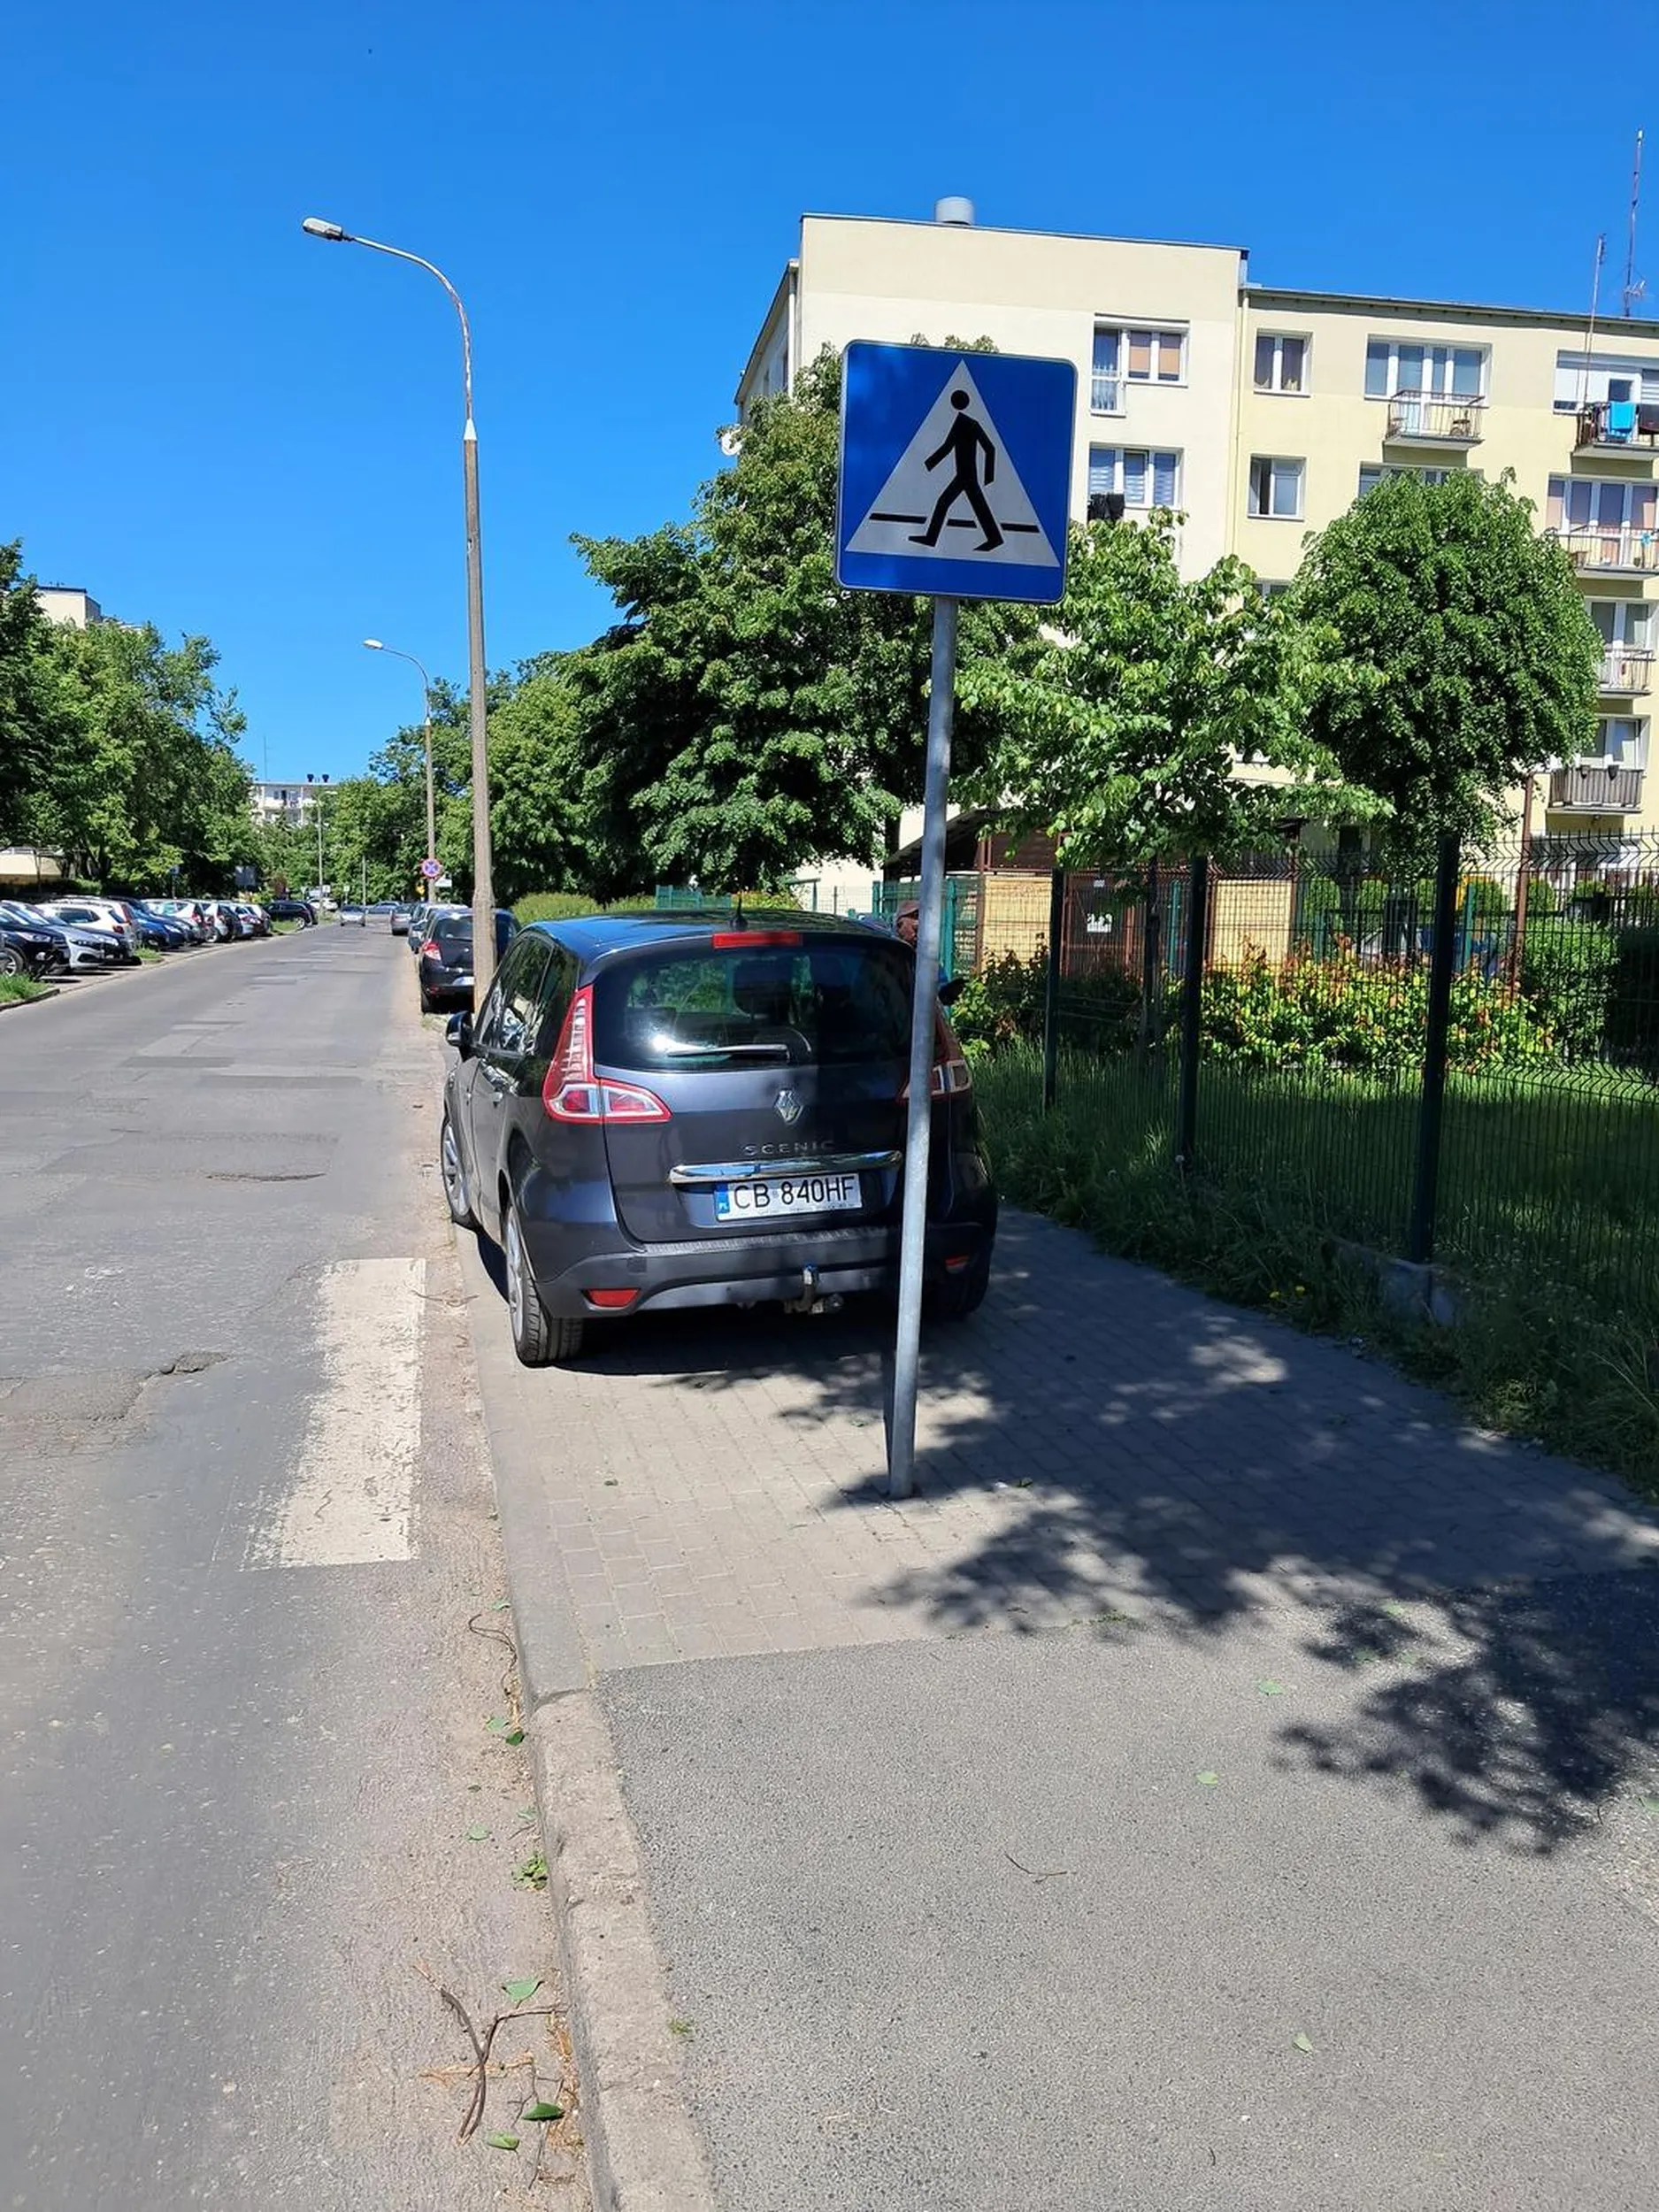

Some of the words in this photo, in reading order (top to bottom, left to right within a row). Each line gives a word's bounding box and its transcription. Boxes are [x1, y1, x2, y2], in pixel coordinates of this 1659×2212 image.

[744, 1140, 834, 1156] SCENIC
[733, 1183, 771, 1210] CB
[780, 1175, 856, 1206] 840HF
